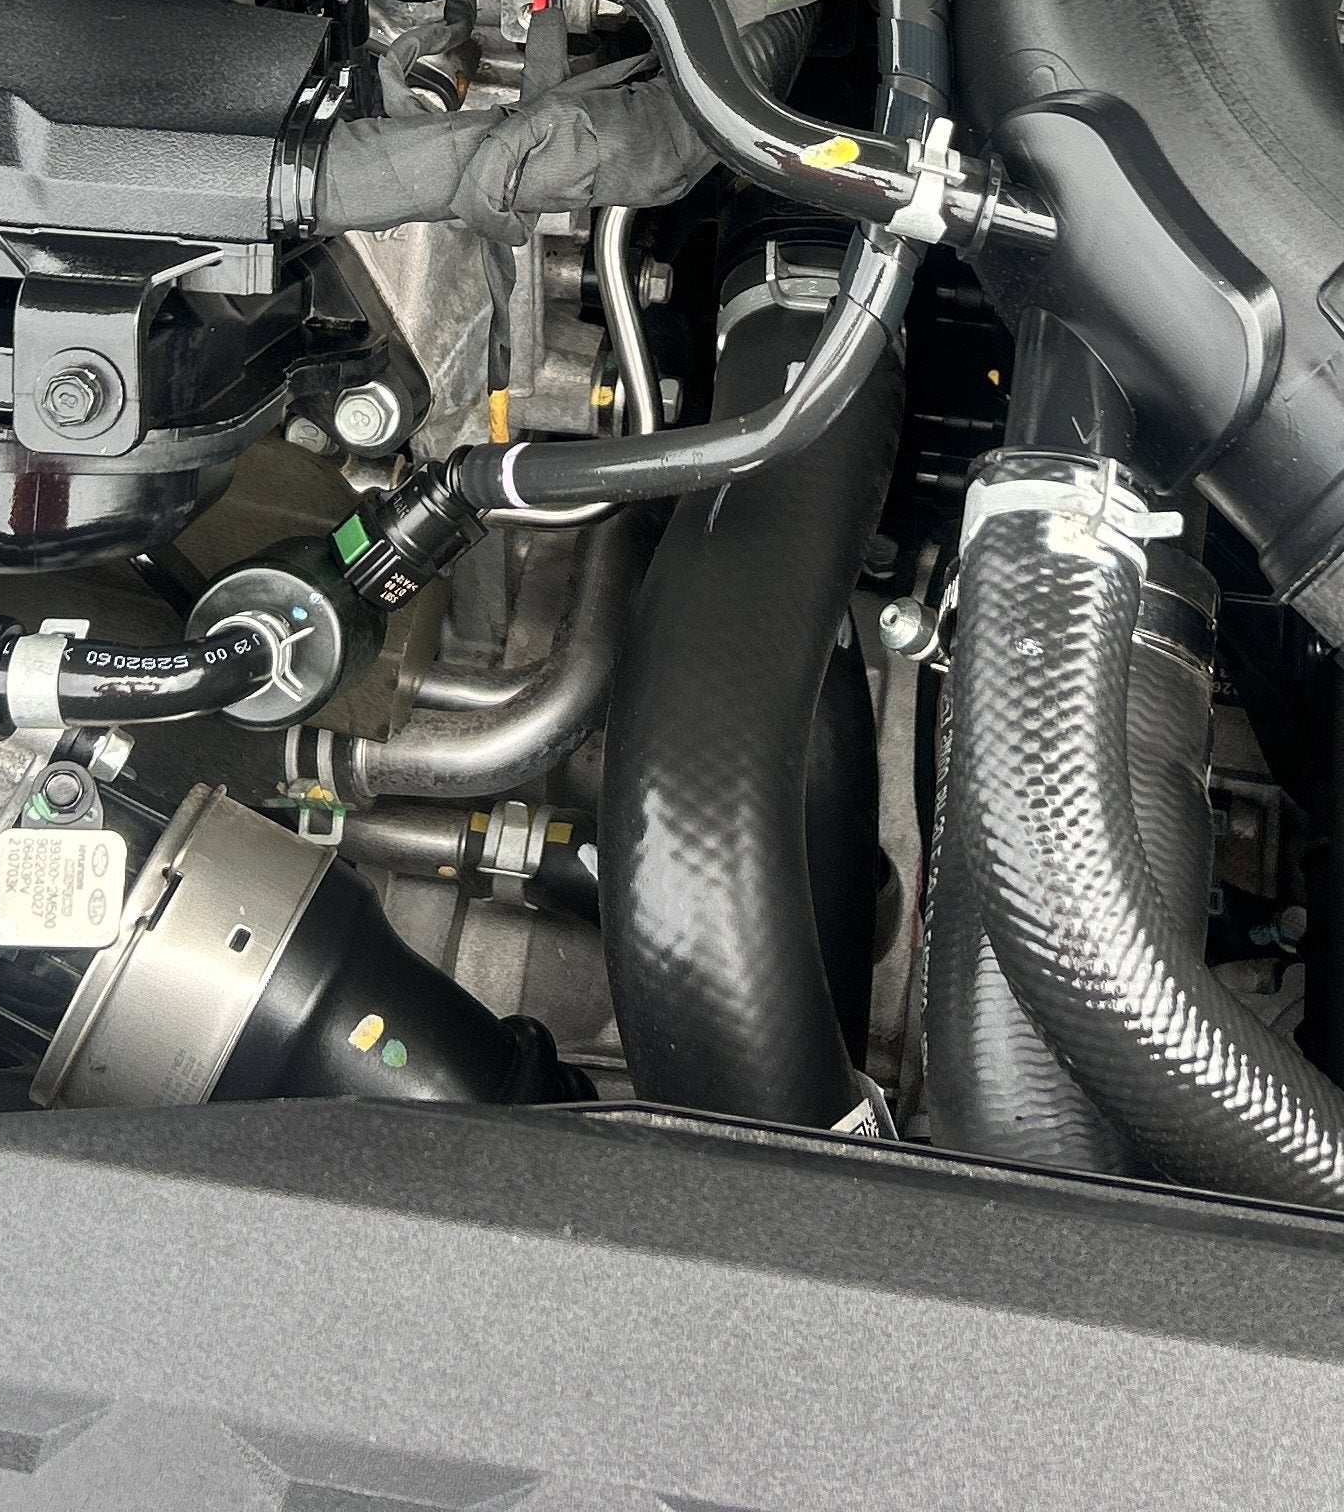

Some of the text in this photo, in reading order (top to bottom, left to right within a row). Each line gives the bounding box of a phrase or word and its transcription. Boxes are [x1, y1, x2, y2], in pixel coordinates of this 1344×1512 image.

[86, 650, 188, 669] 5282060
[32, 839, 48, 918] 9022040027
[44, 839, 62, 928] 39300-2M500
